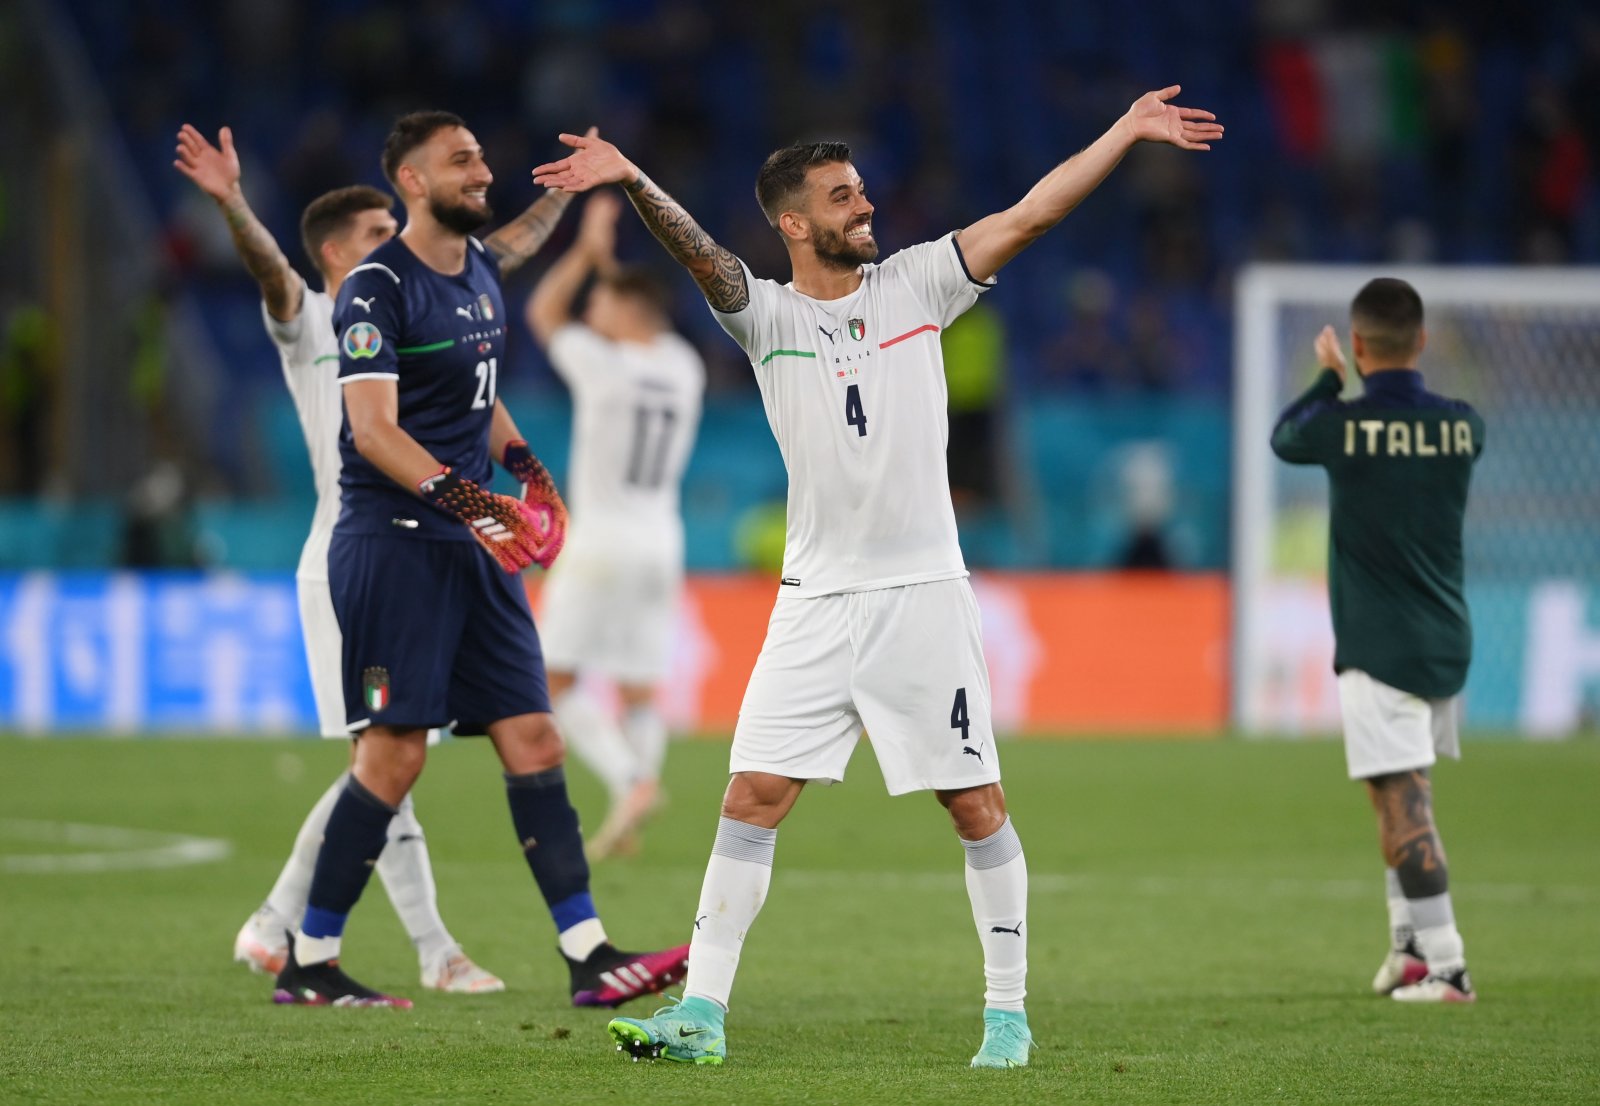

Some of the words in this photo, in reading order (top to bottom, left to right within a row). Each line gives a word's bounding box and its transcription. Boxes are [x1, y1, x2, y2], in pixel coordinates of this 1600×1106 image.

[836, 350, 870, 363] ALIA
[470, 357, 497, 410] 21
[845, 384, 867, 437] 4
[1344, 419, 1474, 456] ITALIA
[950, 687, 970, 740] 4
